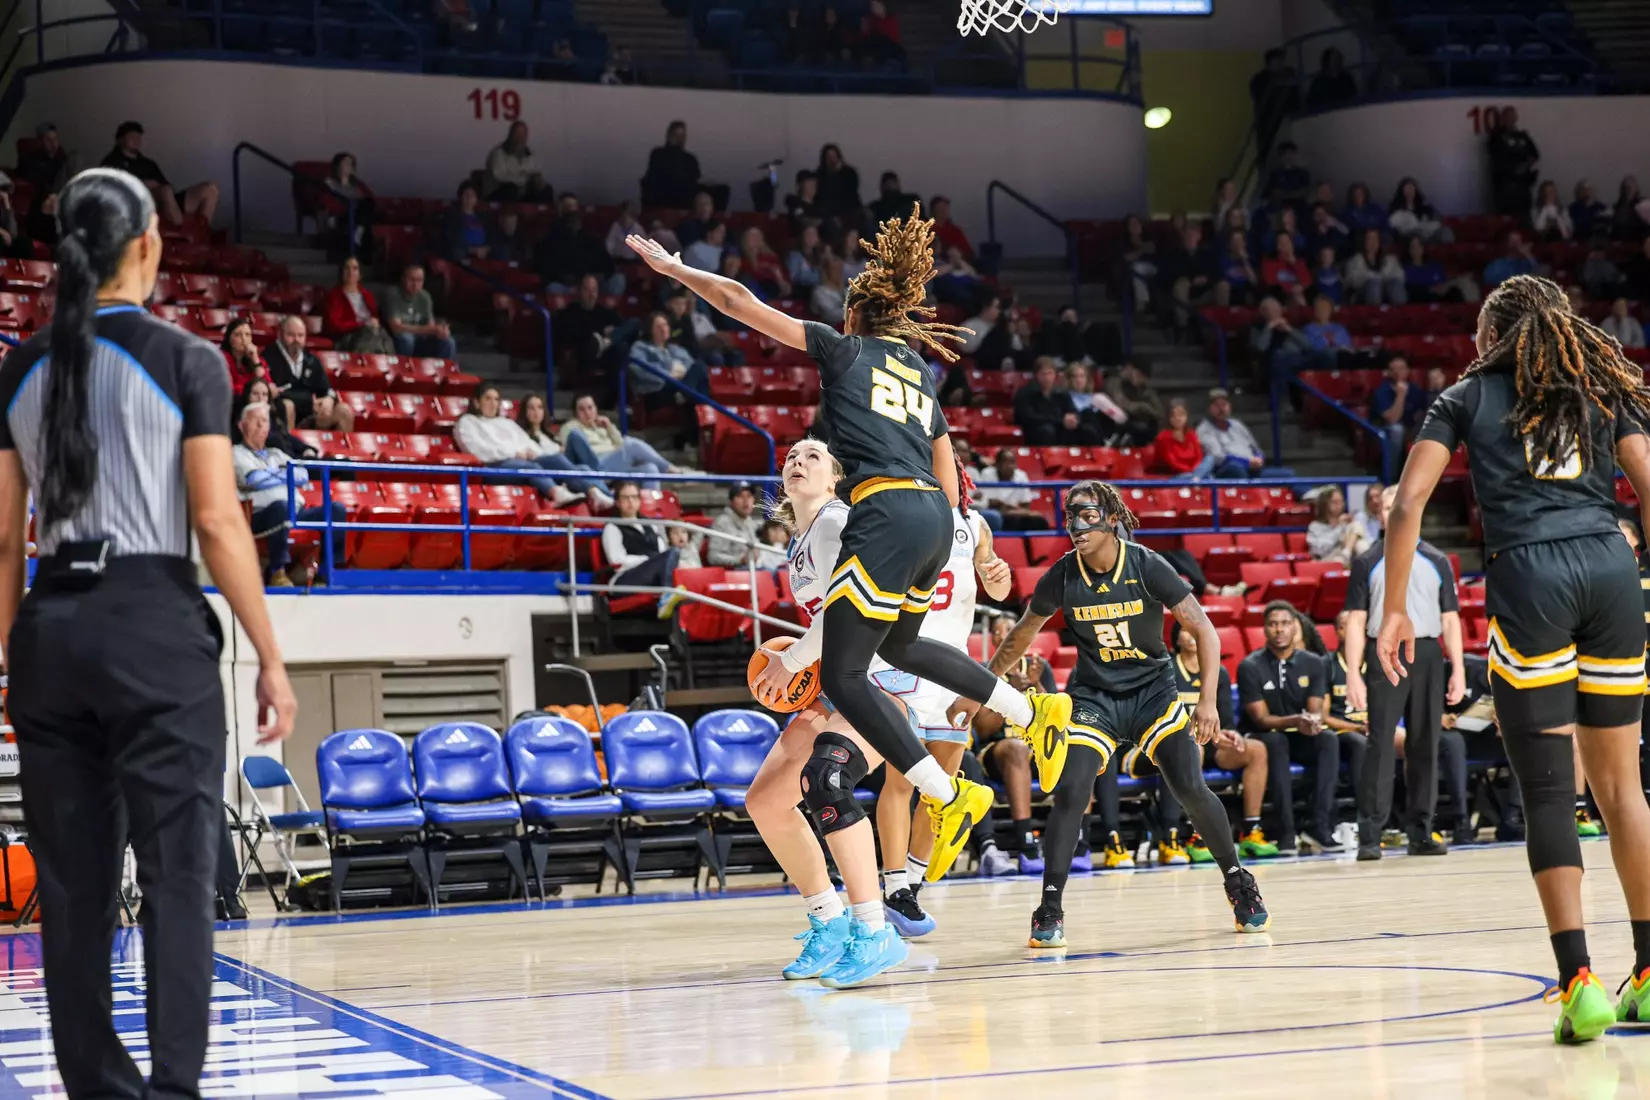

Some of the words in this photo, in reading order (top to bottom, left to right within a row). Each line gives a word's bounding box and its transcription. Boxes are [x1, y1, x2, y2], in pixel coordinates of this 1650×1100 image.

[467, 87, 521, 121] 119
[1466, 104, 1517, 136] 10
[871, 366, 934, 437] 24
[1072, 598, 1144, 622] KENNESAW
[1093, 620, 1132, 648] 21
[788, 670, 814, 705] NCAA
[0, 753, 20, 762] RAD
